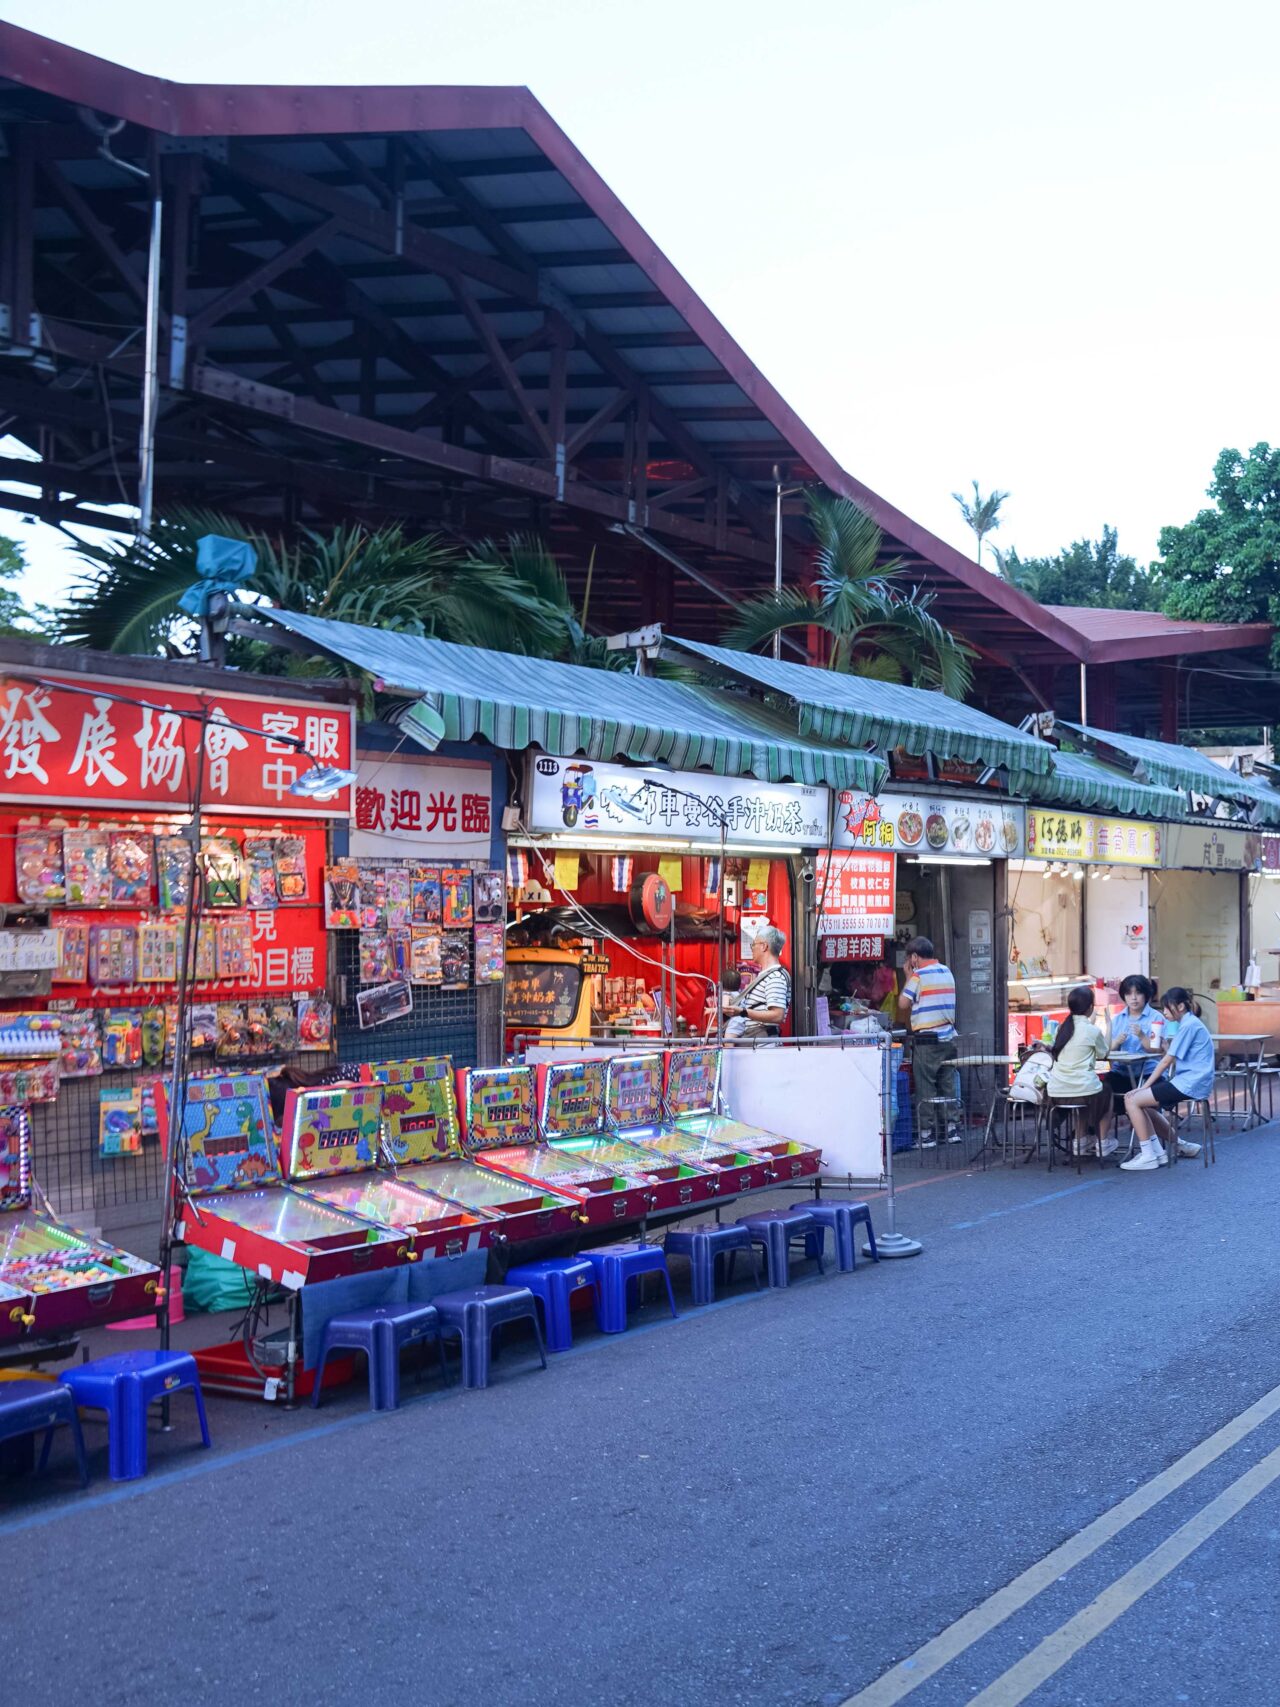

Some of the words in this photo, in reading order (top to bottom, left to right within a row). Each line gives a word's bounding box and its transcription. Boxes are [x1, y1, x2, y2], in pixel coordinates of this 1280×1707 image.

[0, 687, 248, 797] 發展協會
[262, 711, 340, 760] 客服
[538, 758, 558, 773] 1113
[355, 786, 491, 834] 歡迎光臨
[825, 937, 883, 959] 當歸羊肉湯
